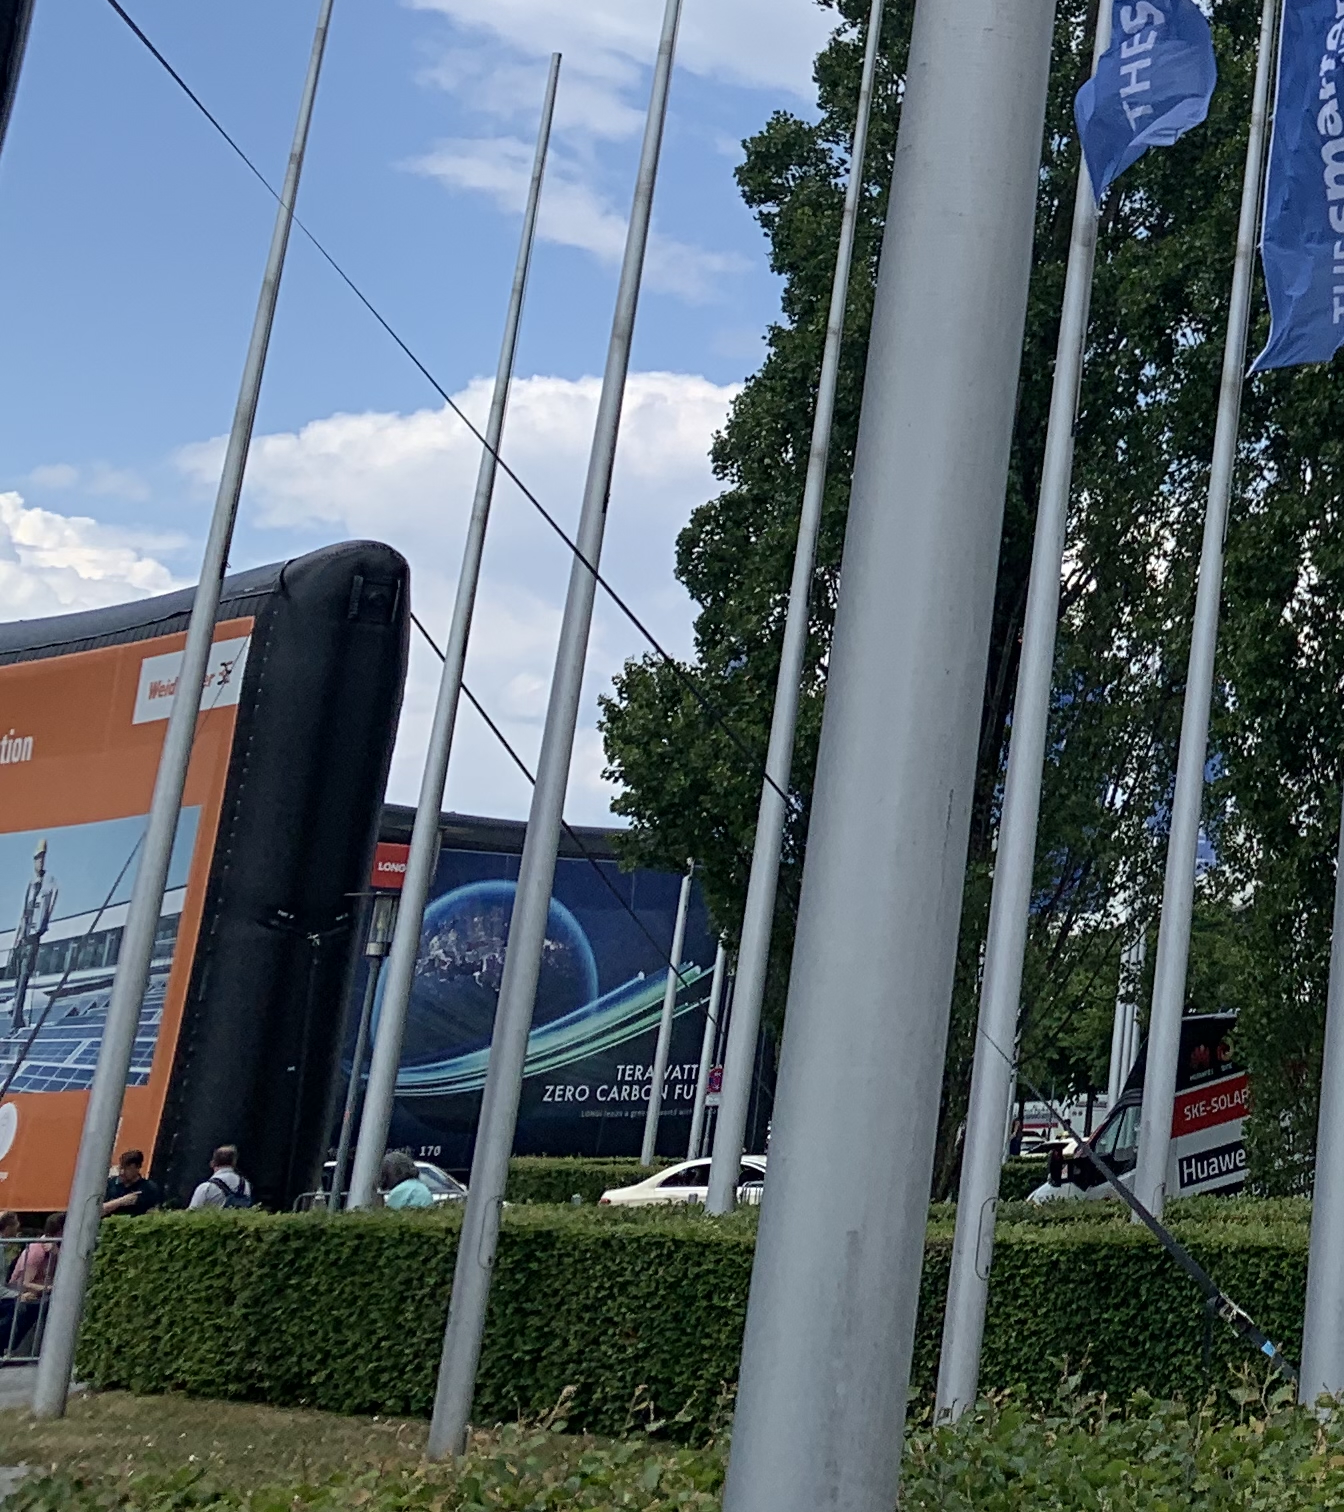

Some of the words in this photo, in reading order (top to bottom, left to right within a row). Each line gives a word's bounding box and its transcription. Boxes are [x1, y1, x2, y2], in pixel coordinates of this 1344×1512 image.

[148, 673, 216, 700] Weider
[377, 861, 407, 873] LONG
[542, 1084, 590, 1102] ZERO
[674, 1083, 699, 1100] FU
[419, 1145, 441, 1156] 170
[1183, 1148, 1247, 1184] Huawe
